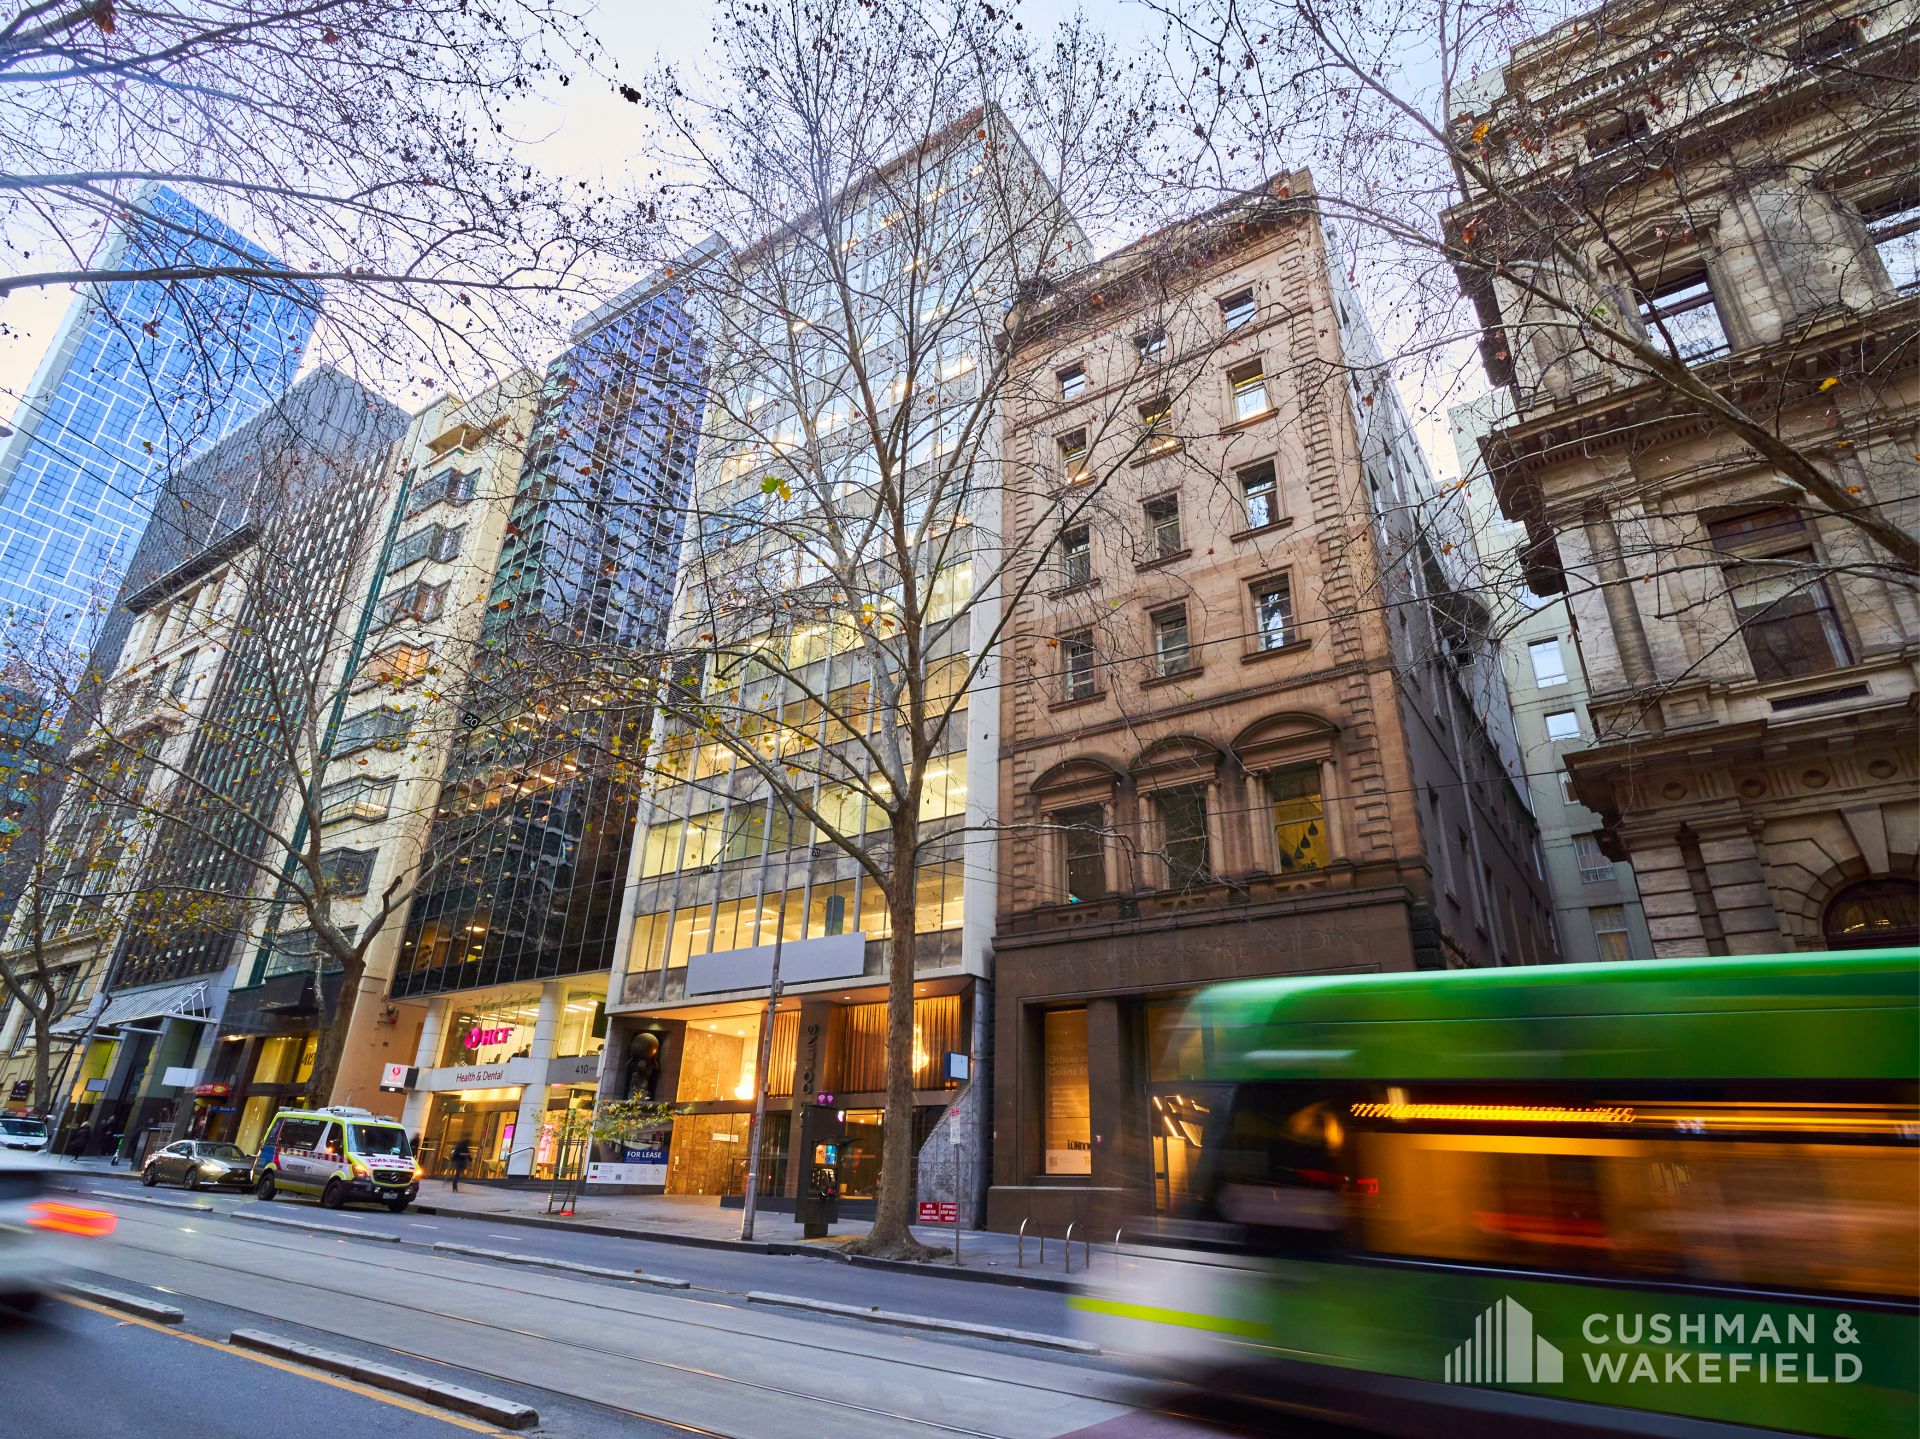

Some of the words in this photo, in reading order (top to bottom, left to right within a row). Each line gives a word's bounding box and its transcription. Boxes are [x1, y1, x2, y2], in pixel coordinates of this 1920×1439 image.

[465, 715, 478, 727] 20
[481, 1026, 514, 1046] HCF
[801, 1023, 819, 1095] COLLINS
[575, 1064, 589, 1074] 410
[456, 1072, 476, 1082] Health
[476, 1070, 482, 1081] &
[482, 1069, 504, 1081] Dental
[642, 1151, 662, 1159] LEASE
